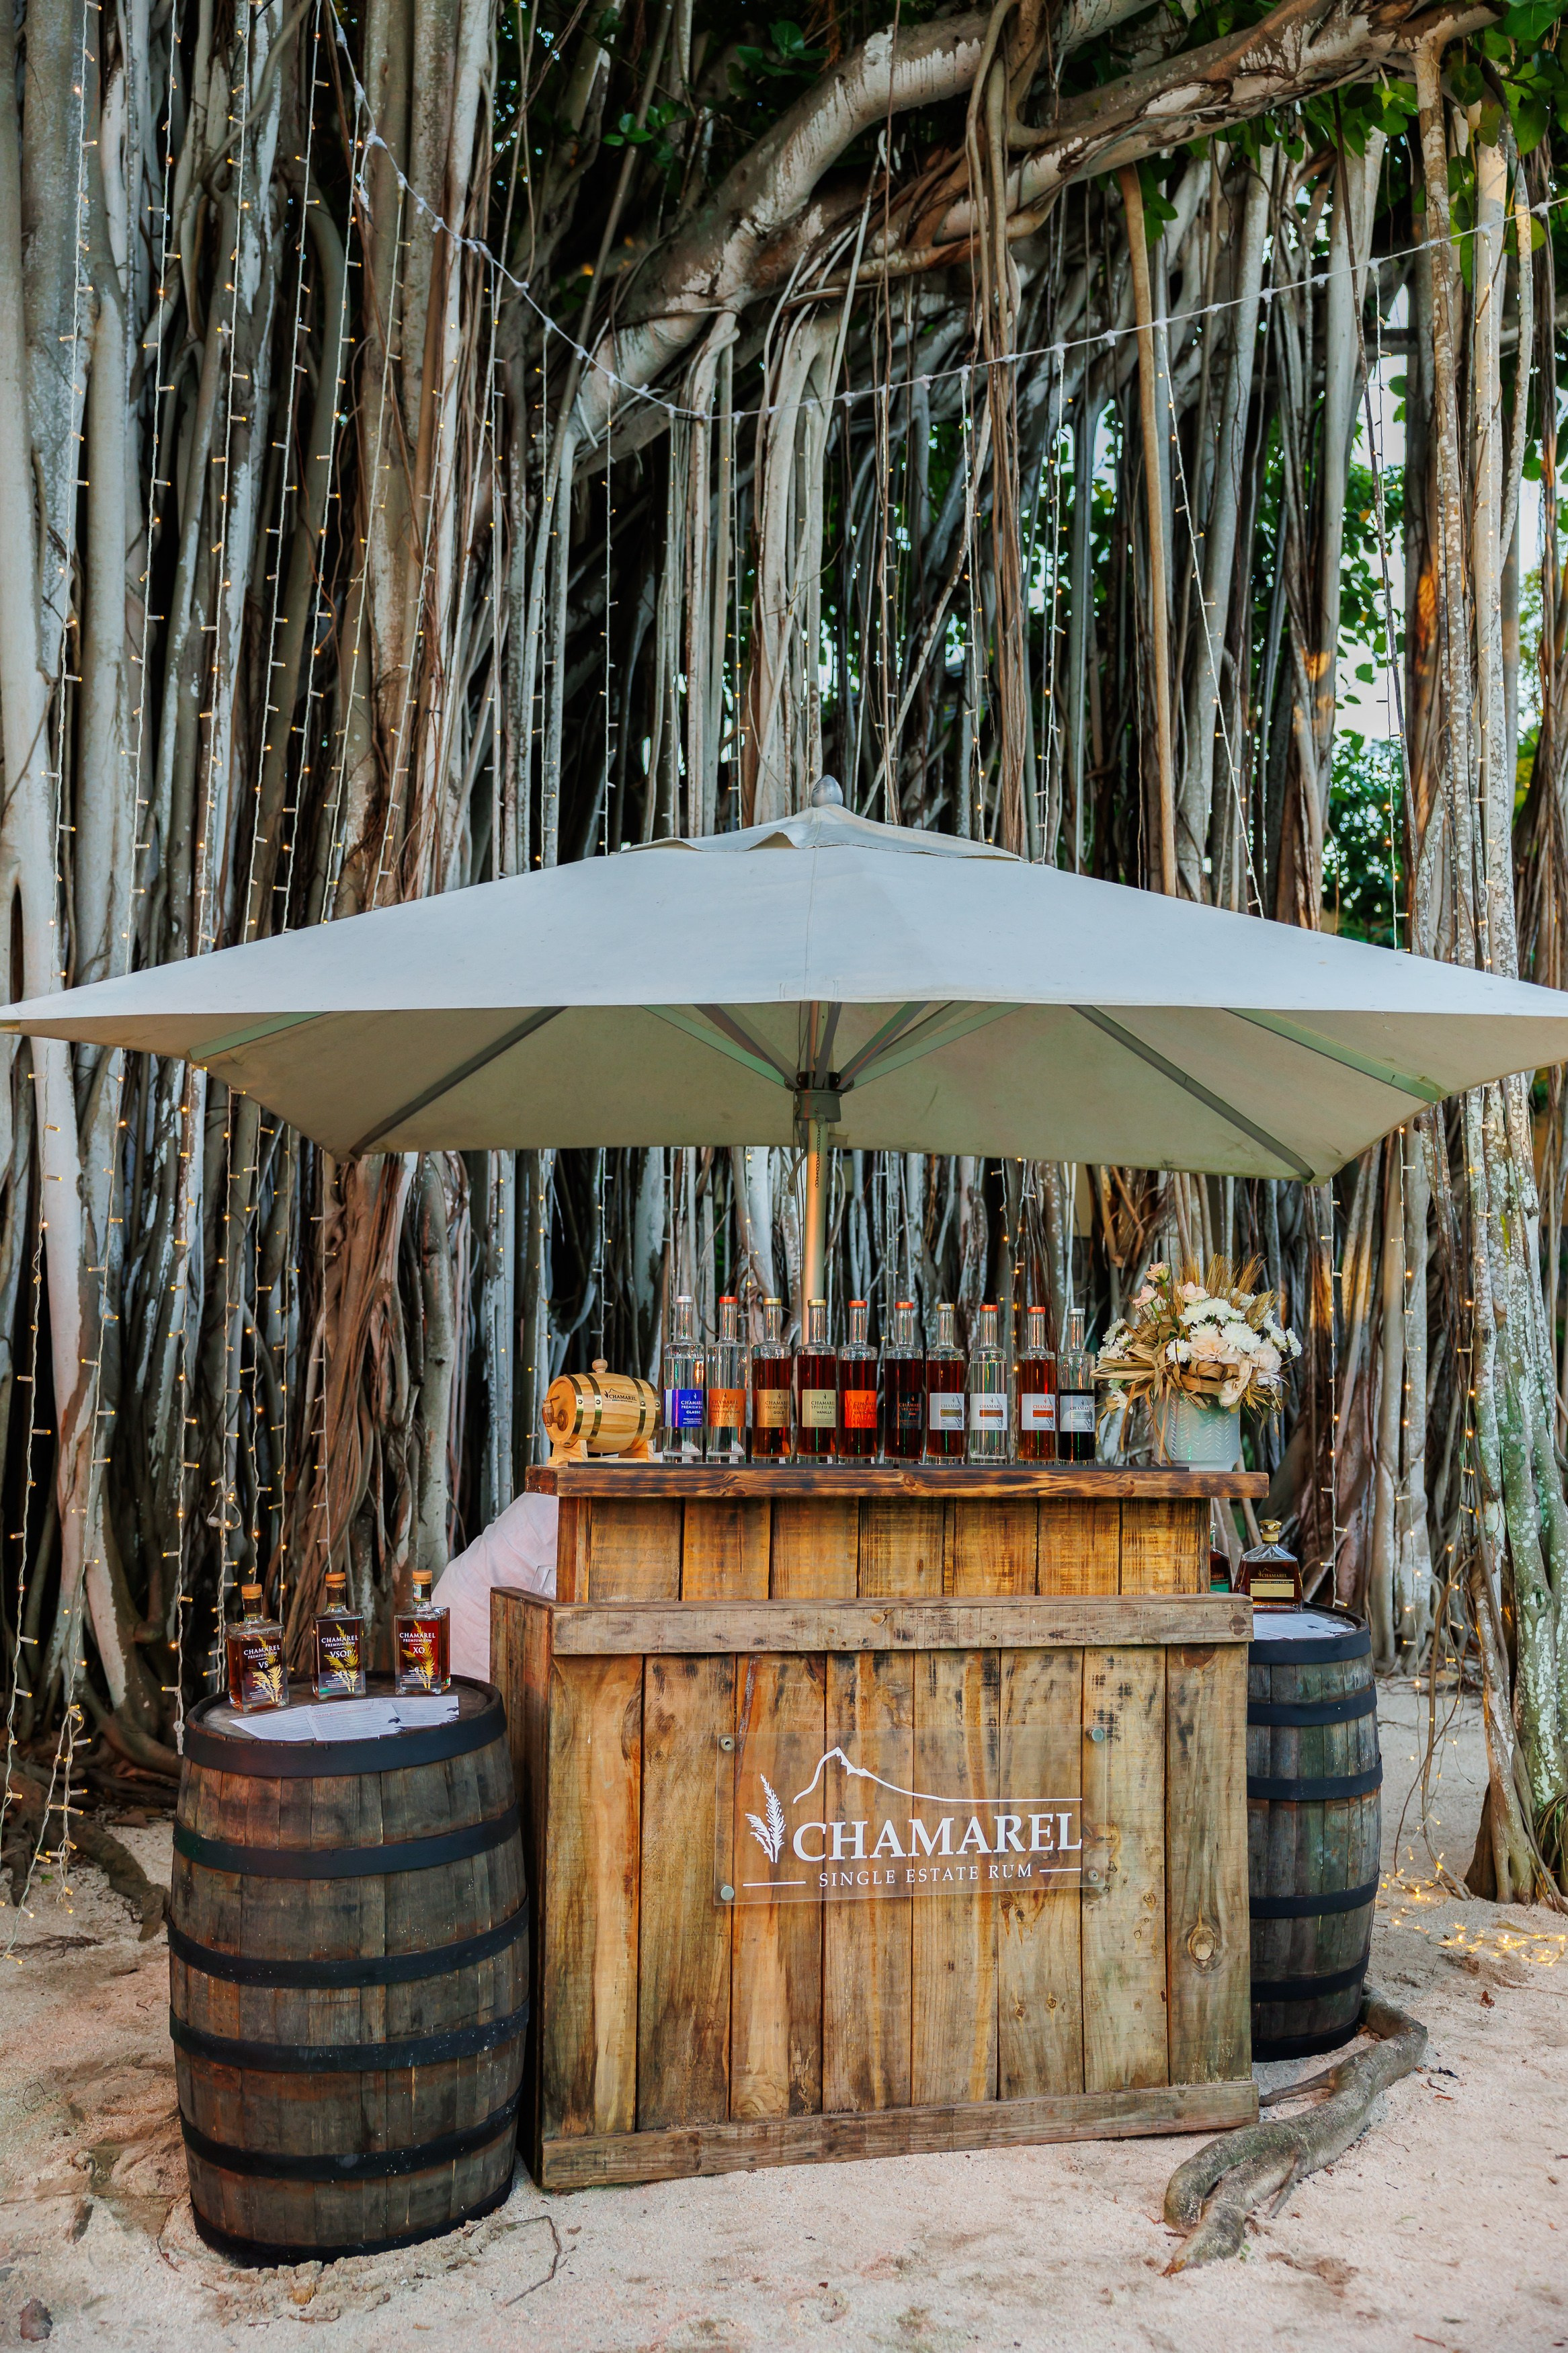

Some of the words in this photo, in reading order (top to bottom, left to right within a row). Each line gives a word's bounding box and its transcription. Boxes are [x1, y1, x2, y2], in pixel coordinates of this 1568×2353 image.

[321, 1634, 359, 1644] CHAMAREL
[243, 1644, 281, 1656] CHAMAREL
[329, 1650, 352, 1658] VSOP
[257, 1661, 269, 1669] VS
[792, 1812, 1082, 1862] CHAMAREL
[819, 1870, 896, 1887] SINGLE
[905, 1866, 979, 1883] ESTATE
[988, 1863, 1033, 1879] RUM
